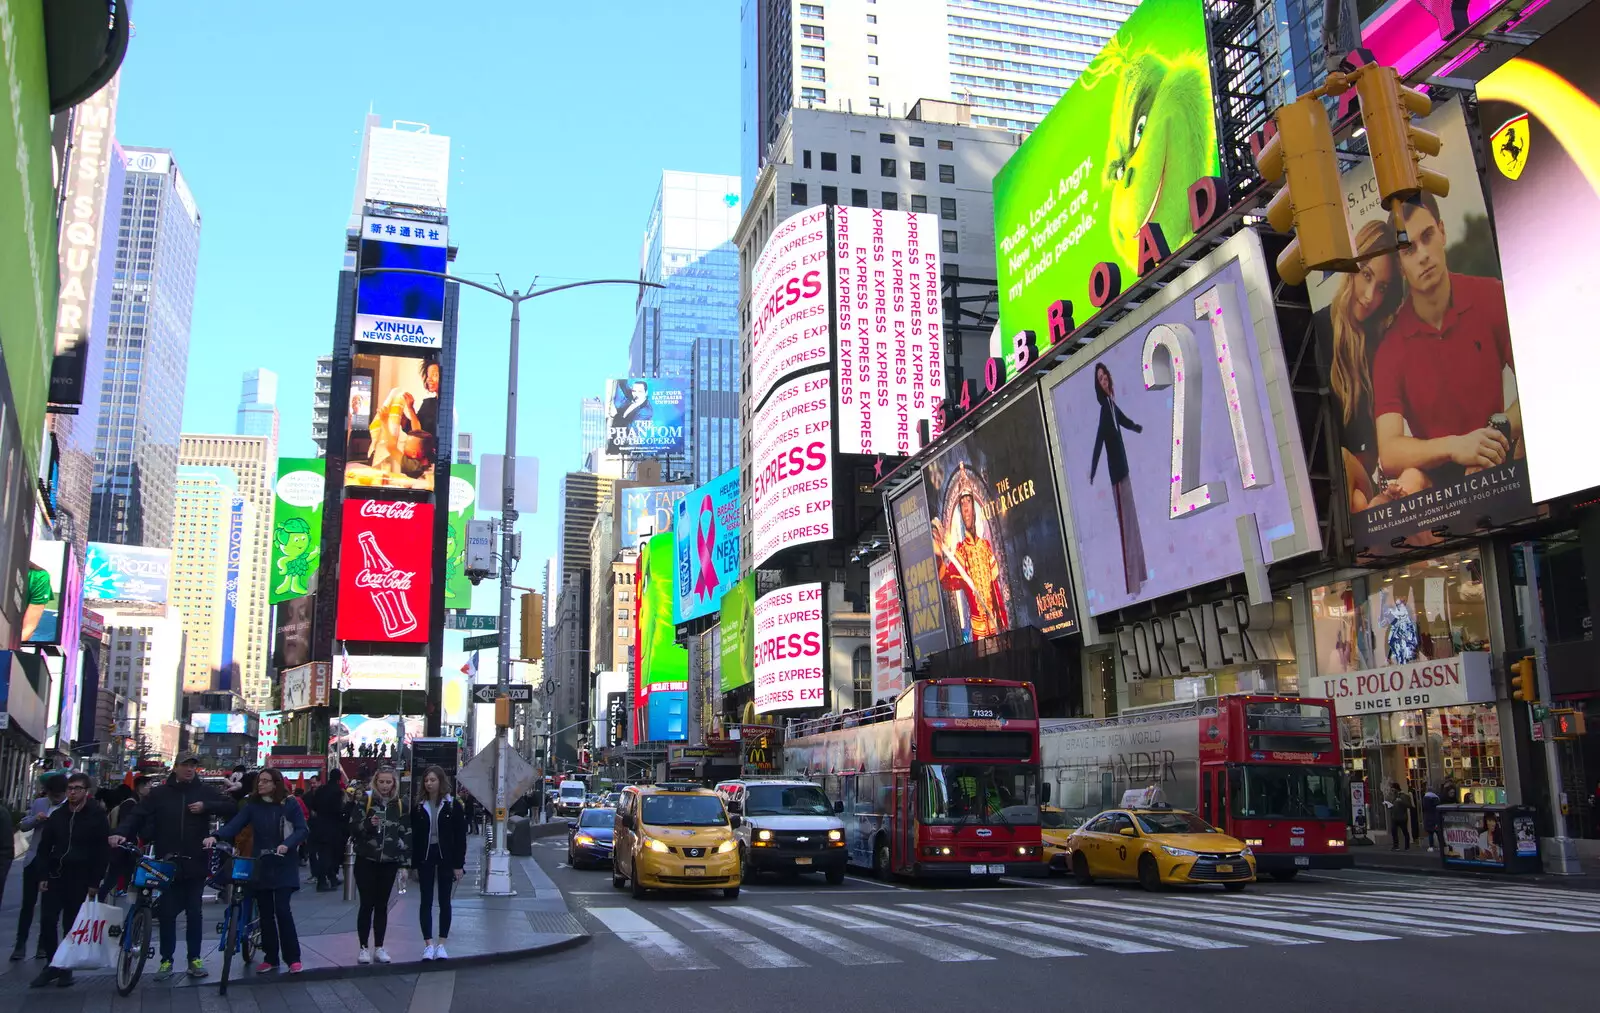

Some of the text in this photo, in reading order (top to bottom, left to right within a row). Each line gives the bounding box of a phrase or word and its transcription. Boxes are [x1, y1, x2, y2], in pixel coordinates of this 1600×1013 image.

[370, 222, 440, 241] 新华通讯社
[780, 230, 823, 257] EXPRESS
[1008, 189, 1089, 276] New Yorkers are
[57, 196, 96, 356] SQUARE
[856, 247, 868, 310] EXPRESS
[892, 250, 904, 312] EXPRESS
[925, 253, 938, 315] EXPRESS
[1008, 279, 1023, 302] my
[1025, 251, 1053, 287] kinda
[753, 270, 822, 348] EXPRESS
[839, 267, 851, 331] EXPRESS
[875, 270, 887, 333] EXPRESS
[909, 273, 922, 336] EXPRESS
[375, 321, 425, 336] XINHUA
[781, 304, 825, 329] EXPRESS
[363, 331, 436, 345] NEWS AGENCY
[858, 317, 870, 382] EXPRESS
[895, 320, 907, 385] EXPRESS
[781, 346, 826, 370] EXPRESS
[928, 323, 941, 387] EXPRESS
[841, 339, 852, 405] EXPRESS
[876, 342, 888, 407] EXPRESS
[912, 344, 925, 409] EXPRESS
[781, 398, 827, 421] EXPRESS
[1142, 283, 1266, 520] 21
[608, 426, 683, 439] PHANTOM
[635, 420, 653, 428] THE
[613, 437, 676, 446] OF THE OPERA
[755, 441, 827, 504] EXPRESS
[782, 477, 828, 499] EXPRESS
[996, 477, 1010, 494] THE
[360, 499, 417, 519] Coca-Cola
[628, 493, 651, 509] MY
[717, 500, 738, 517] BREAST
[1367, 466, 1518, 524] LIVE AUTHENTICALLY
[1368, 521, 1388, 533] PAMELA
[1388, 514, 1417, 529] FLANAGAN
[1424, 506, 1445, 517] JONNY
[1446, 499, 1467, 510] LAVINE
[1473, 492, 1491, 504] POLO
[1492, 481, 1521, 496] PLAYERS
[229, 510, 244, 572] NOVOTEL
[783, 523, 829, 542] EXPRESS
[108, 554, 167, 576] FROZEN
[355, 568, 416, 590] Coca-Cola
[905, 556, 936, 587] COME
[458, 616, 468, 628] W
[472, 616, 484, 628] 45
[913, 603, 940, 634] AWAY
[754, 631, 821, 668] EXPRESS
[1114, 595, 1259, 684] FOREVER
[1324, 663, 1460, 699] U.S. POLO ASSN
[972, 709, 993, 717] 71323
[1355, 693, 1430, 711] SINCE 1890
[1066, 730, 1161, 750] BRAVE THE NEW WORLD
[1055, 750, 1178, 785] OUTLANDER
[1447, 829, 1478, 844] WAITRESS
[72, 919, 108, 945] H&M
